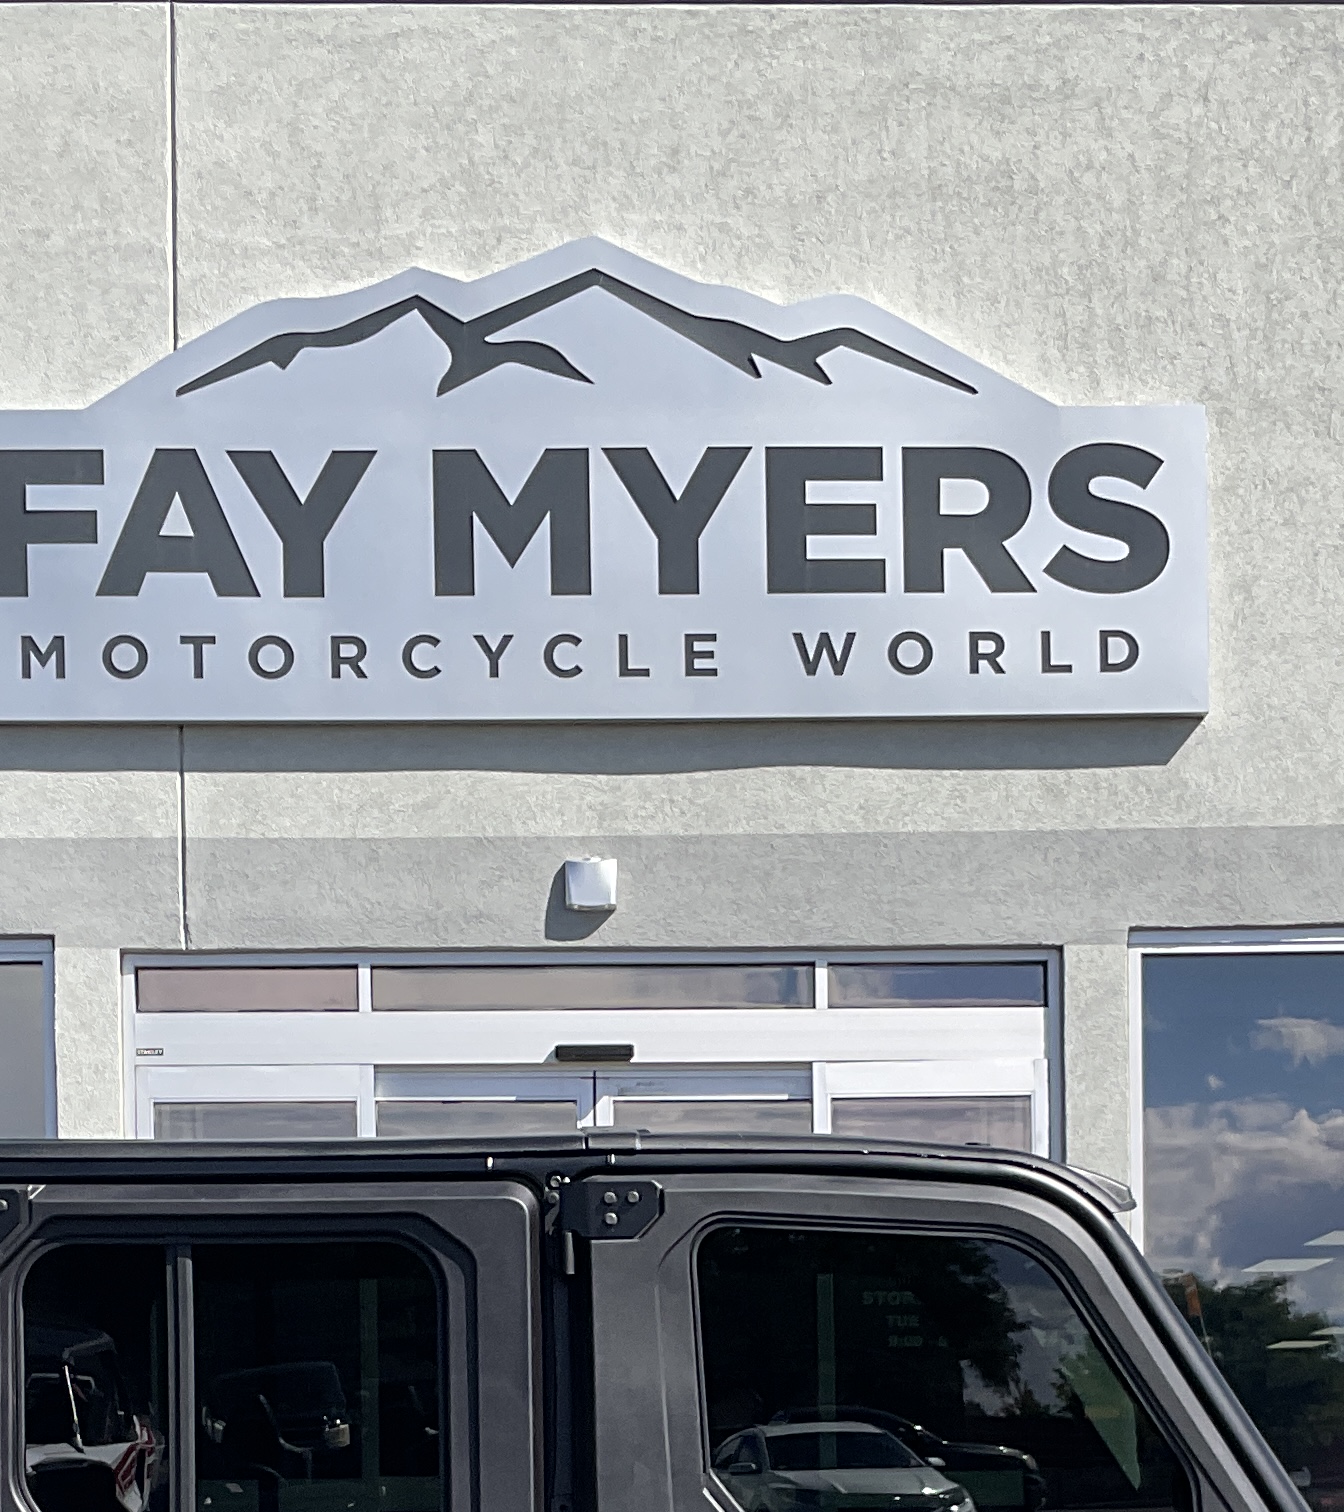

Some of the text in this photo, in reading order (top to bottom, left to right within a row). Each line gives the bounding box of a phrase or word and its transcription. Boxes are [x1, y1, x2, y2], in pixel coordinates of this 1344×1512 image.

[431, 441, 1172, 598] MYERS
[19, 627, 1142, 681] MOTORCYCLE WORLD
